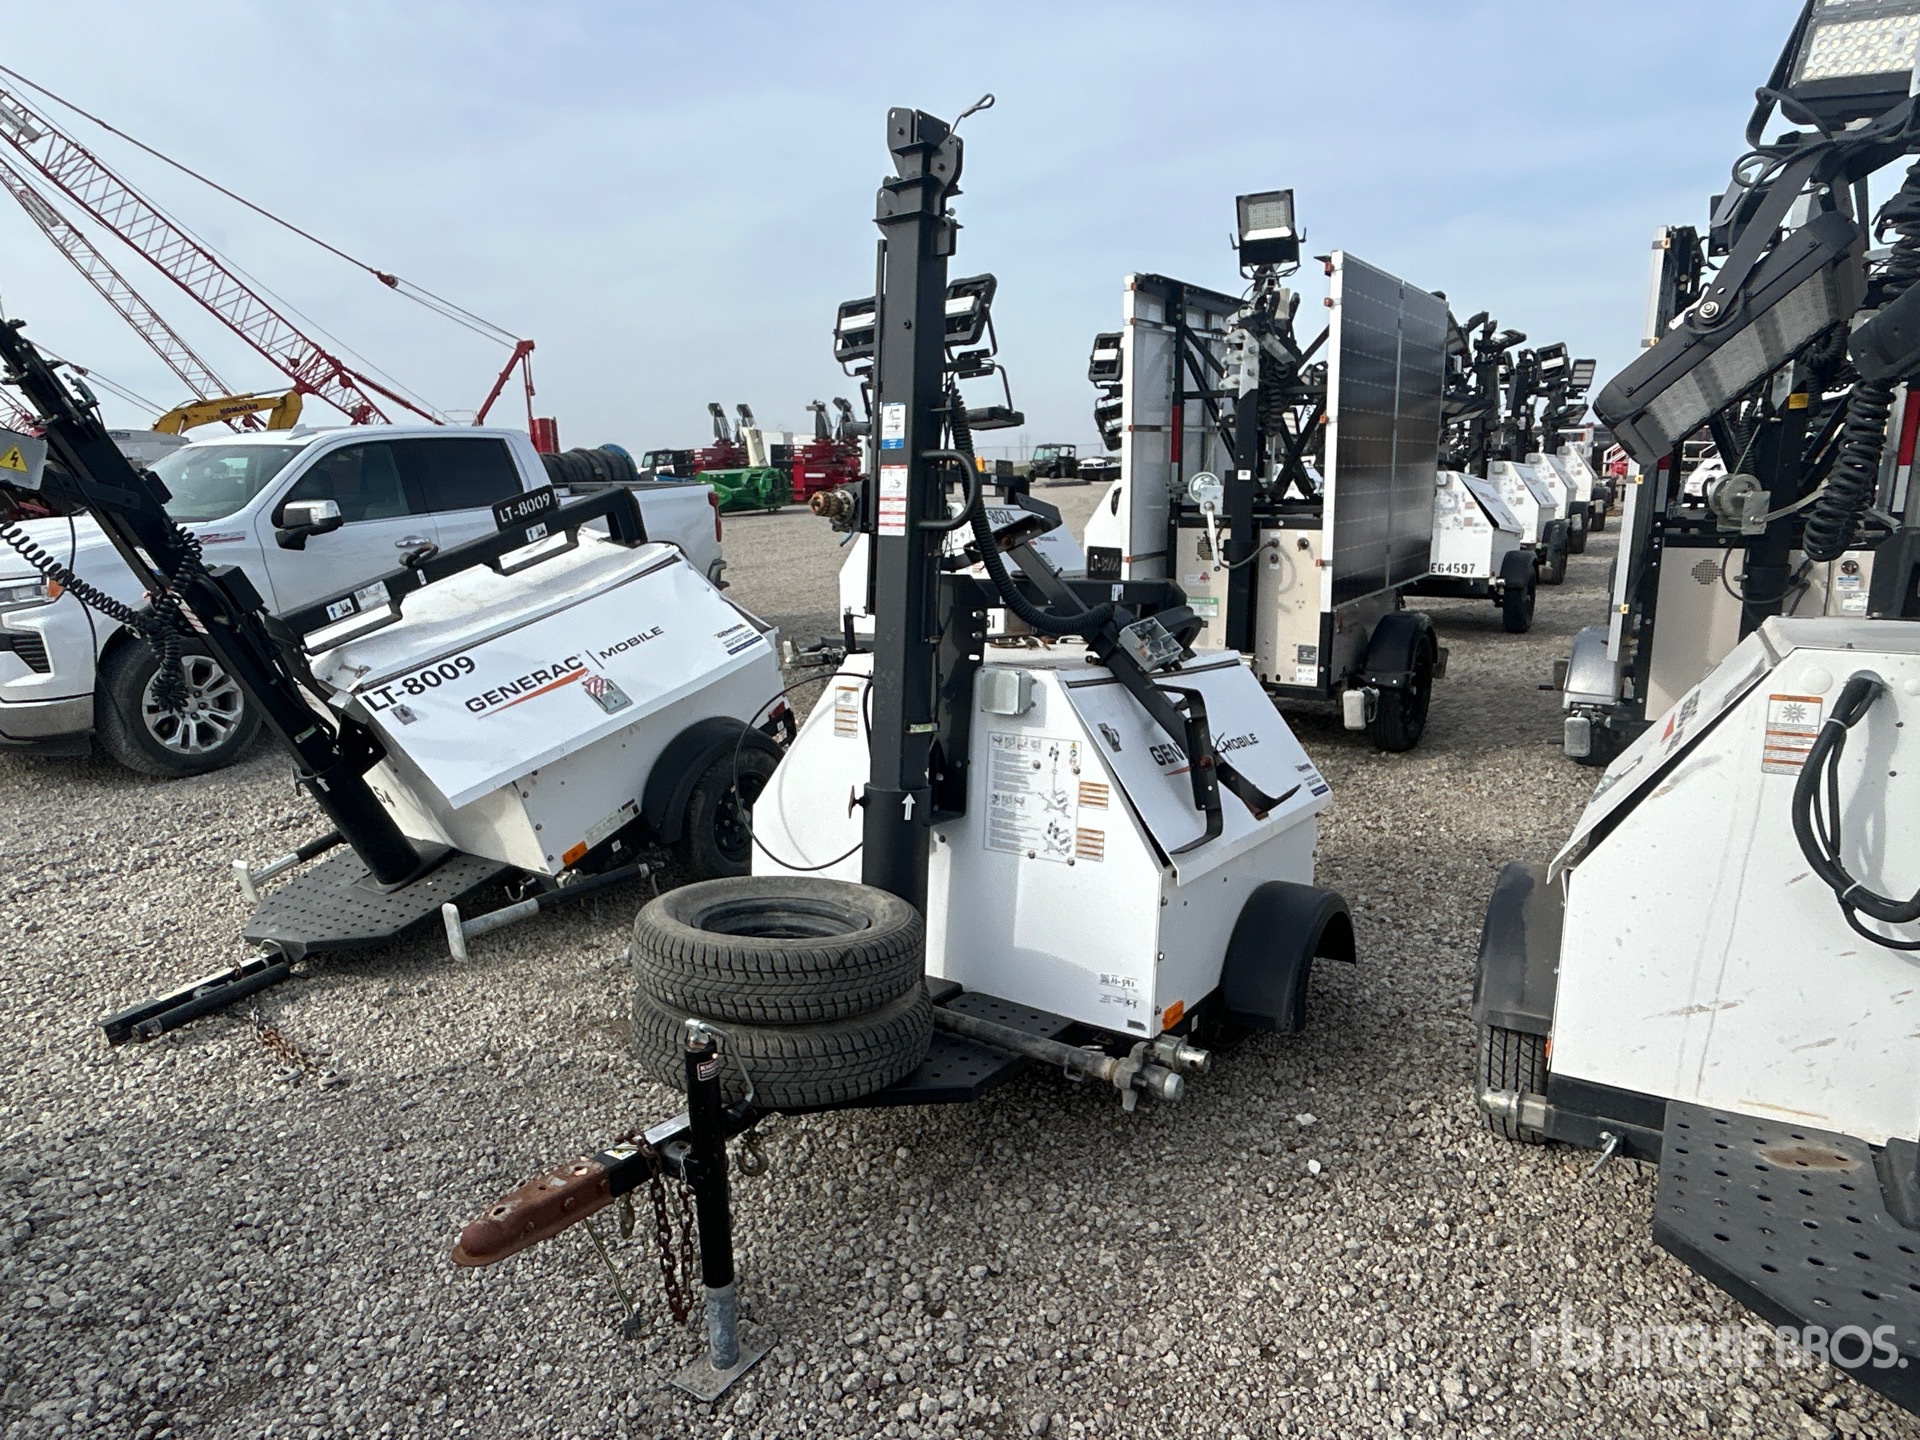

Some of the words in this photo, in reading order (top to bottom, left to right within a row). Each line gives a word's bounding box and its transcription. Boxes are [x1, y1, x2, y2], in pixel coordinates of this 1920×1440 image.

[219, 403, 259, 414] KOMATSU
[499, 492, 550, 523] LT-8009
[1430, 562, 1475, 575] E64597
[464, 655, 584, 714] GENERAC
[599, 625, 664, 660] MOBILE
[361, 655, 476, 713] LT-8009
[1222, 732, 1259, 752] MOBILE
